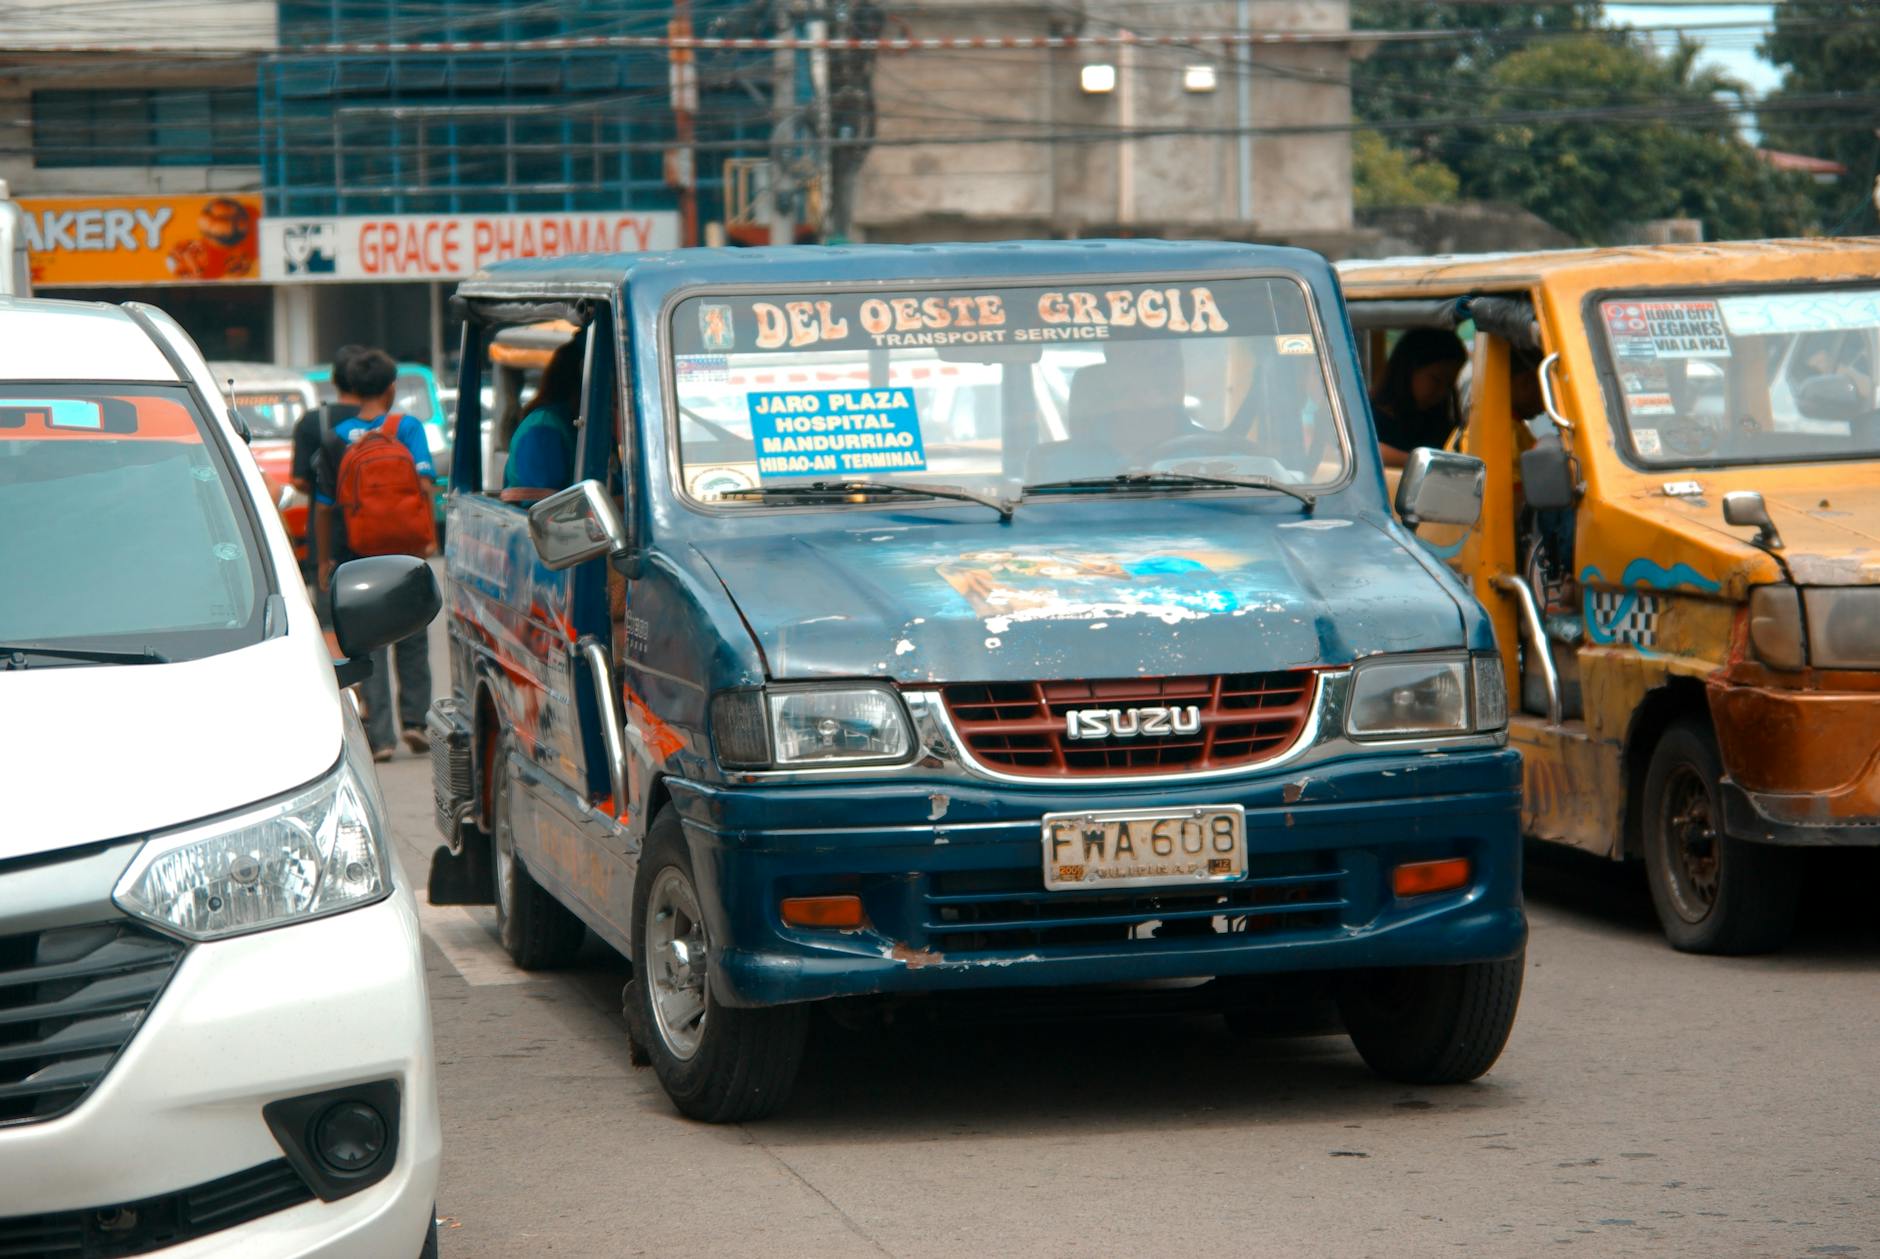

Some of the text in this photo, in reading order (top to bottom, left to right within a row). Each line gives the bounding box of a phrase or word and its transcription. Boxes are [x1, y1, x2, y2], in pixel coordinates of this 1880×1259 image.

[358, 216, 655, 273] GRACE PHARMACY
[752, 287, 1229, 349] DEL OESTE GRECIA
[1645, 308, 1716, 320] ILOILO CITY
[871, 325, 1110, 347] TRANSPORT SERVICE
[1649, 320, 1722, 336] LEGANES
[1654, 338, 1681, 351] VIA
[1682, 338, 1699, 351] LA
[1700, 338, 1727, 350] PAZ
[755, 391, 909, 414] JARO PLAZA
[775, 413, 895, 433] HOSPITAL
[762, 431, 914, 453] MANDURRIAO
[759, 451, 924, 473] HIBAO-AN TERMINAL
[1066, 705, 1201, 740] ISUZU
[1050, 815, 1234, 864] FWA 608
